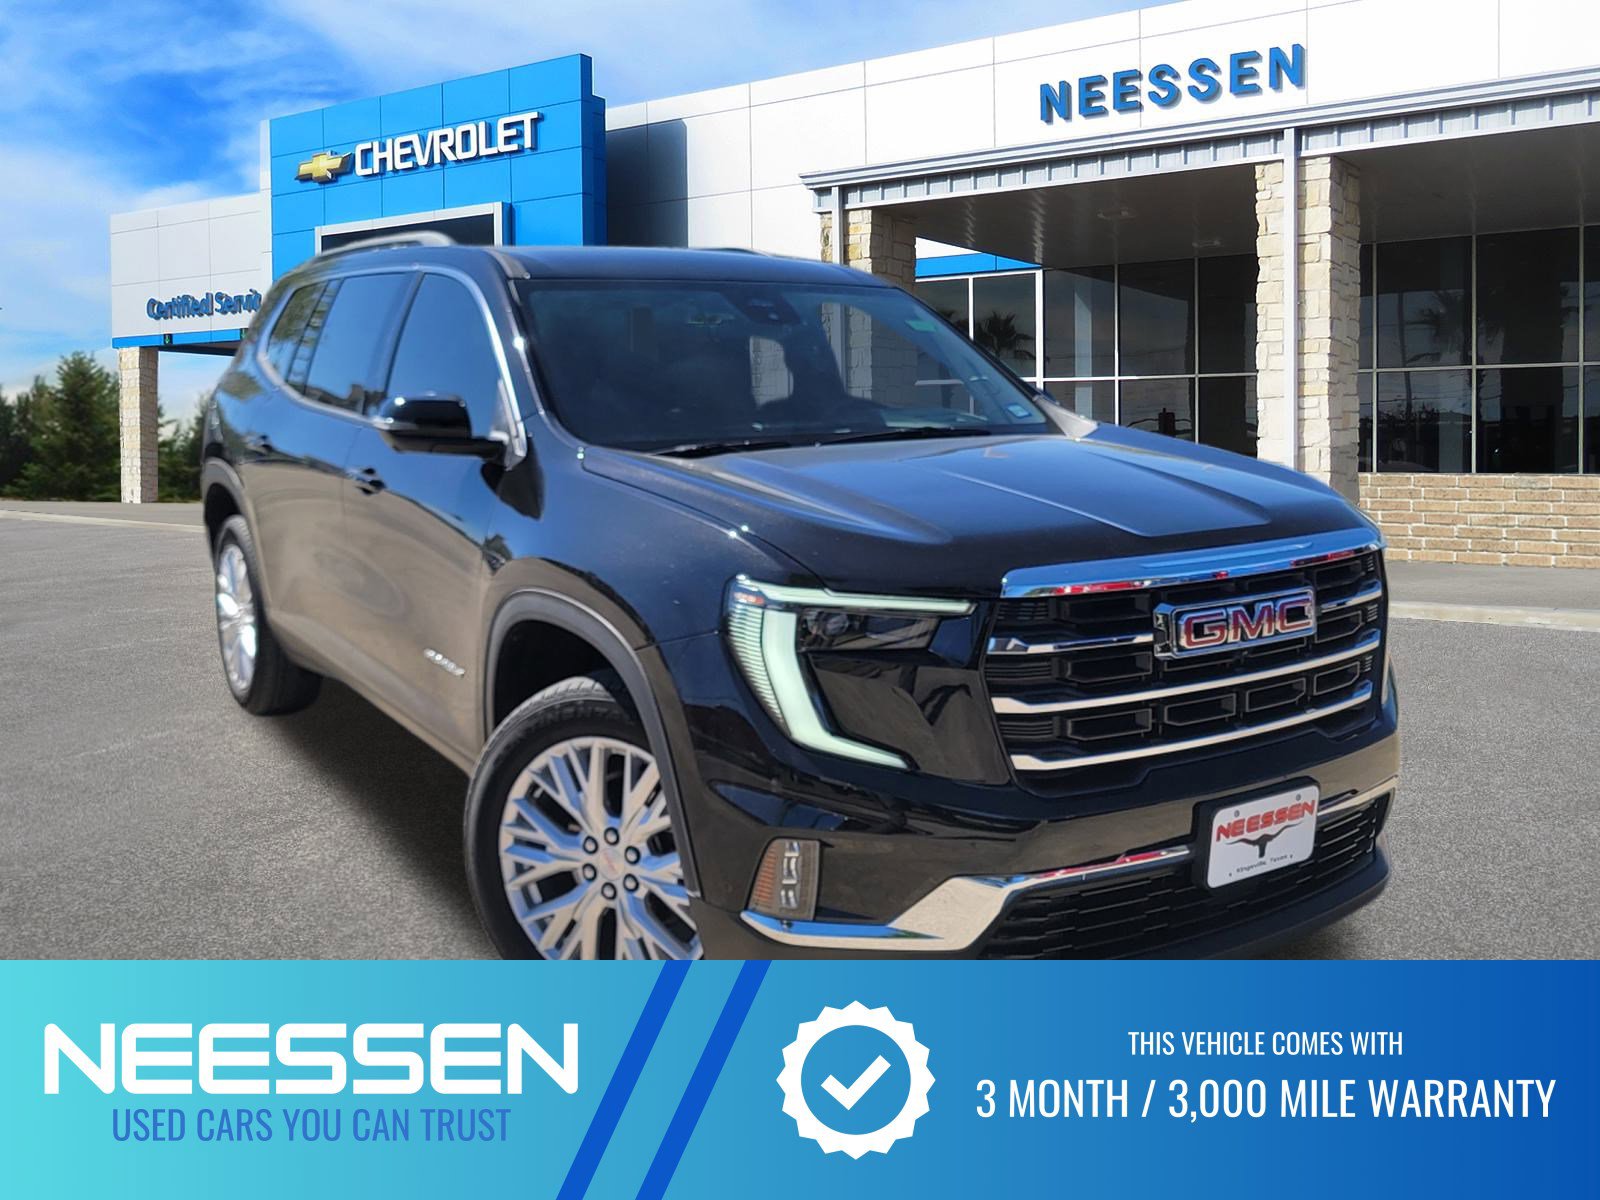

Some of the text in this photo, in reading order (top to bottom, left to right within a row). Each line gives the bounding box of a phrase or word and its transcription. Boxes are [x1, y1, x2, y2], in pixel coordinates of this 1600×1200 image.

[1040, 43, 1305, 124] NEESSEN
[353, 110, 543, 177] CHEVROLET
[146, 292, 214, 320] Certified
[1178, 594, 1315, 650] GMC
[1216, 799, 1316, 842] NEESSEN
